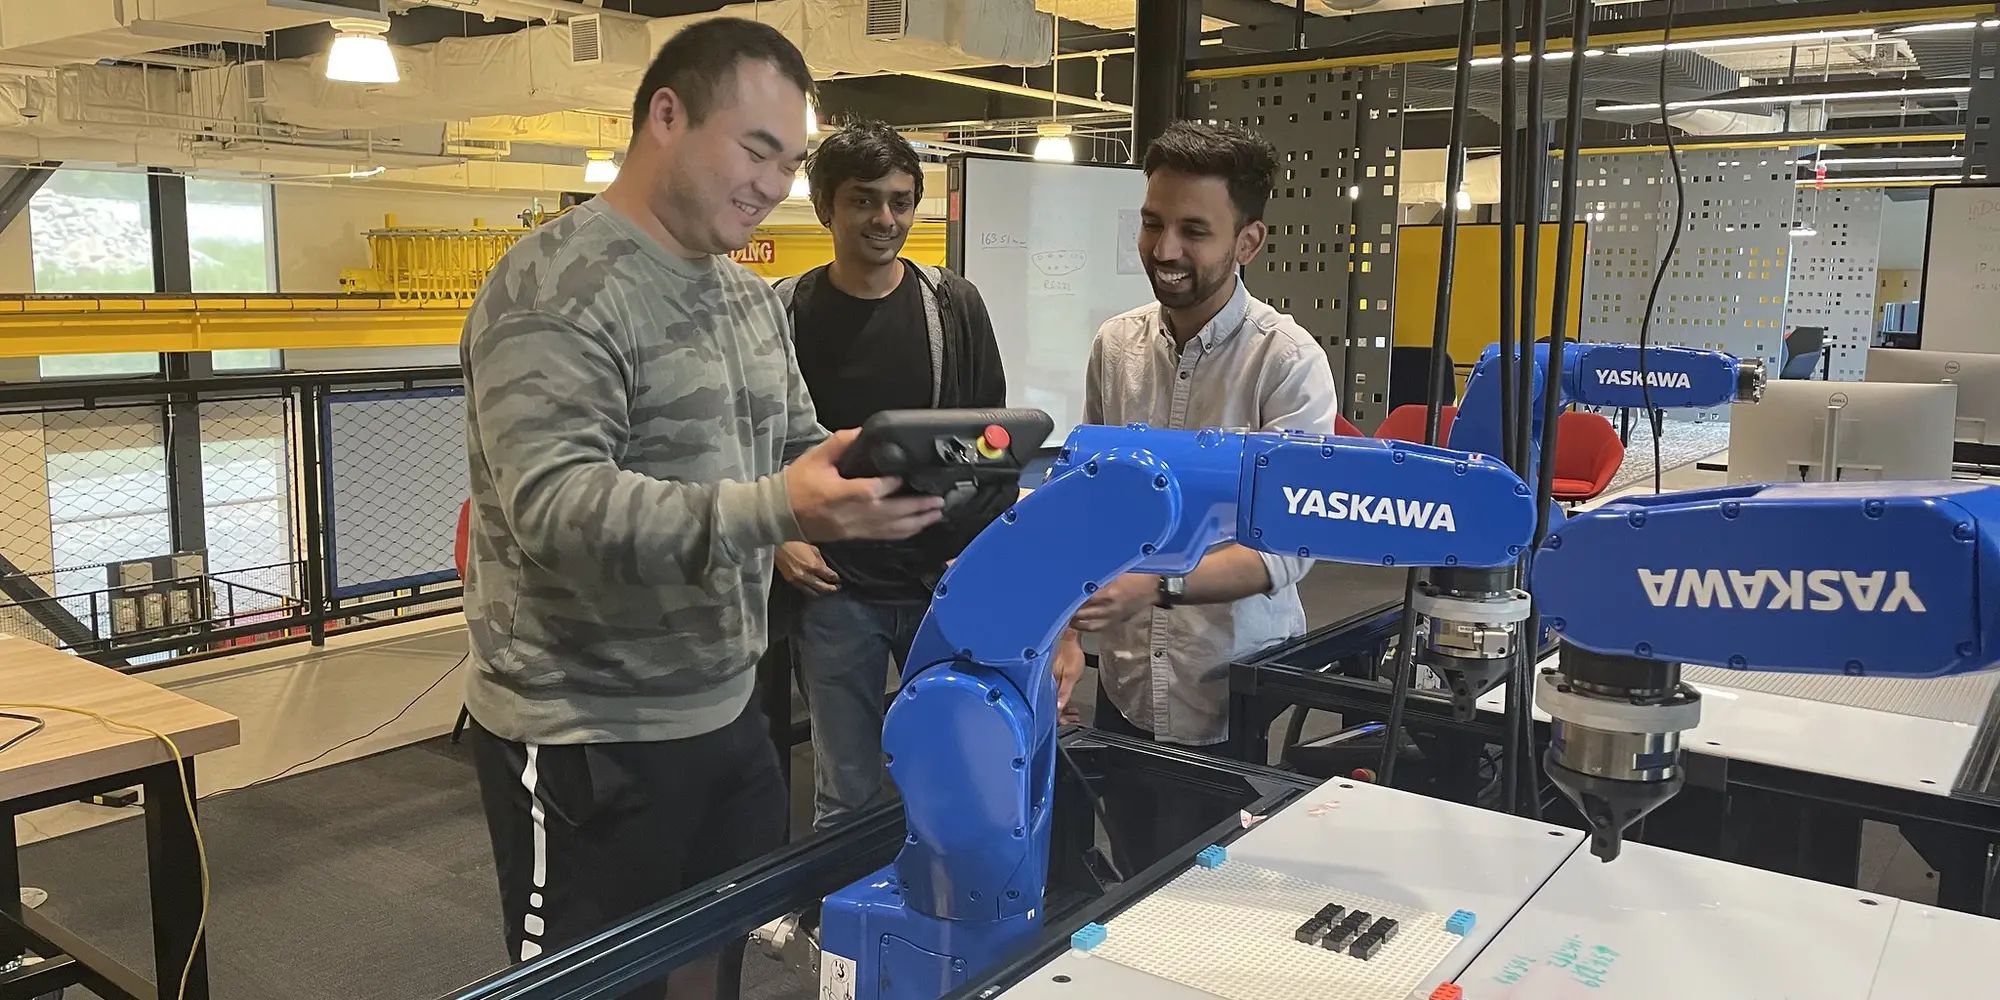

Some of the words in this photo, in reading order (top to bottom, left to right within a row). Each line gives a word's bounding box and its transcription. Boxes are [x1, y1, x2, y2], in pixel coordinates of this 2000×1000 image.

[1595, 369, 1691, 389] YASKAWA
[1282, 486, 1456, 532] YASKAWA
[1637, 568, 1927, 612] YASKAWA
